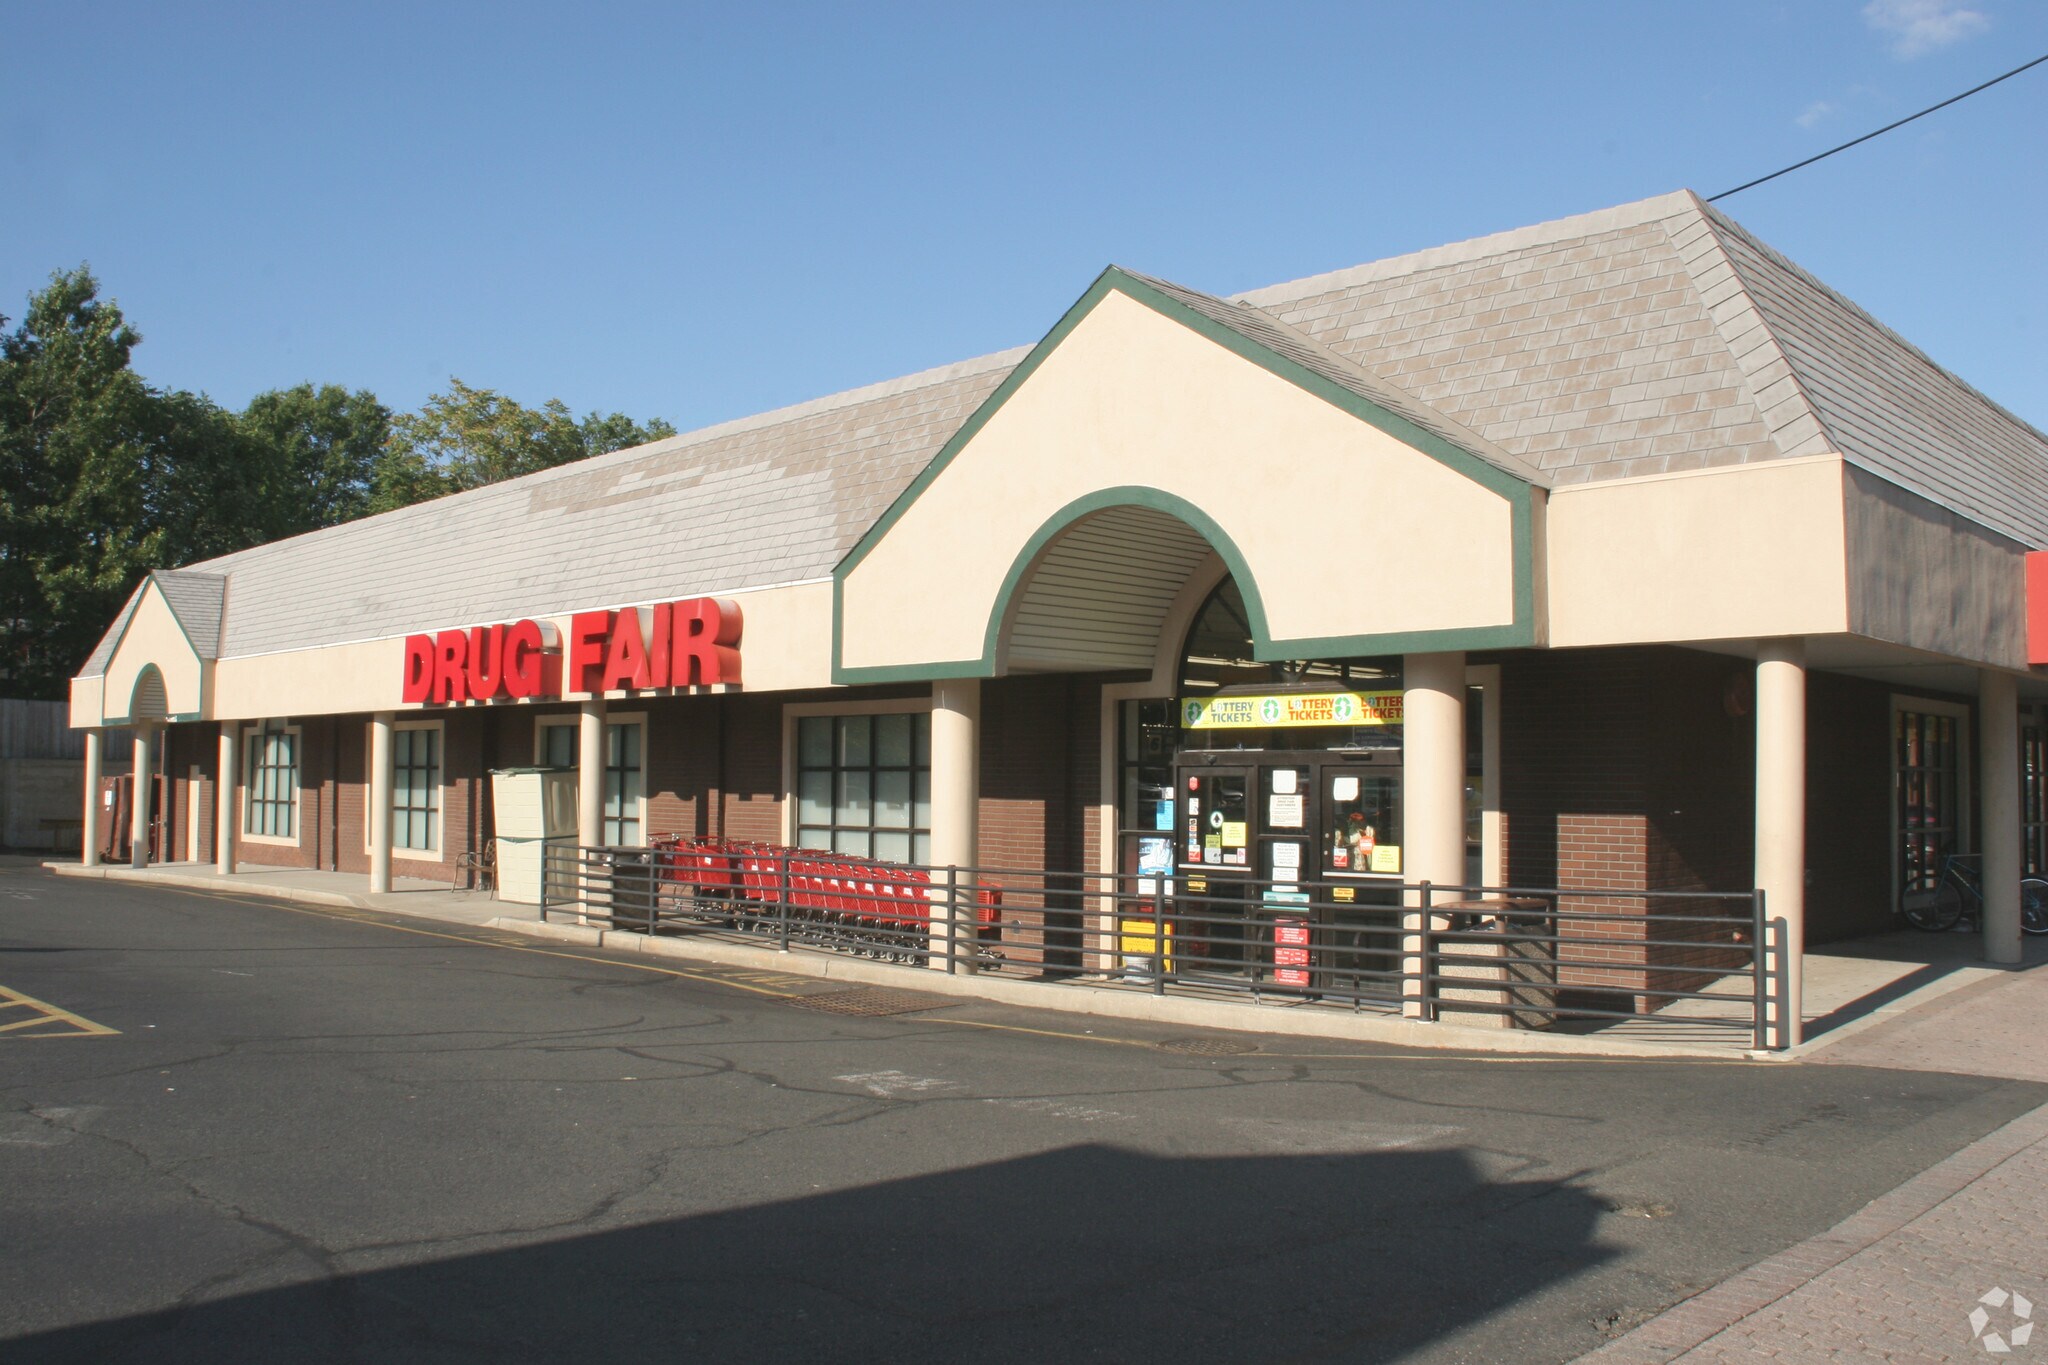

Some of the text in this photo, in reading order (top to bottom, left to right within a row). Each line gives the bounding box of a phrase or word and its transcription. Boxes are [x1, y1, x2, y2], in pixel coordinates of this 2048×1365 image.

[402, 597, 743, 704] DRUG FAIR
[1210, 702, 1253, 712] LOTTERY
[1288, 698, 1334, 710] LOTTERY
[1361, 695, 1404, 708] LOTTER
[1211, 712, 1252, 723] TICKETS
[1289, 709, 1333, 721] TICKETS
